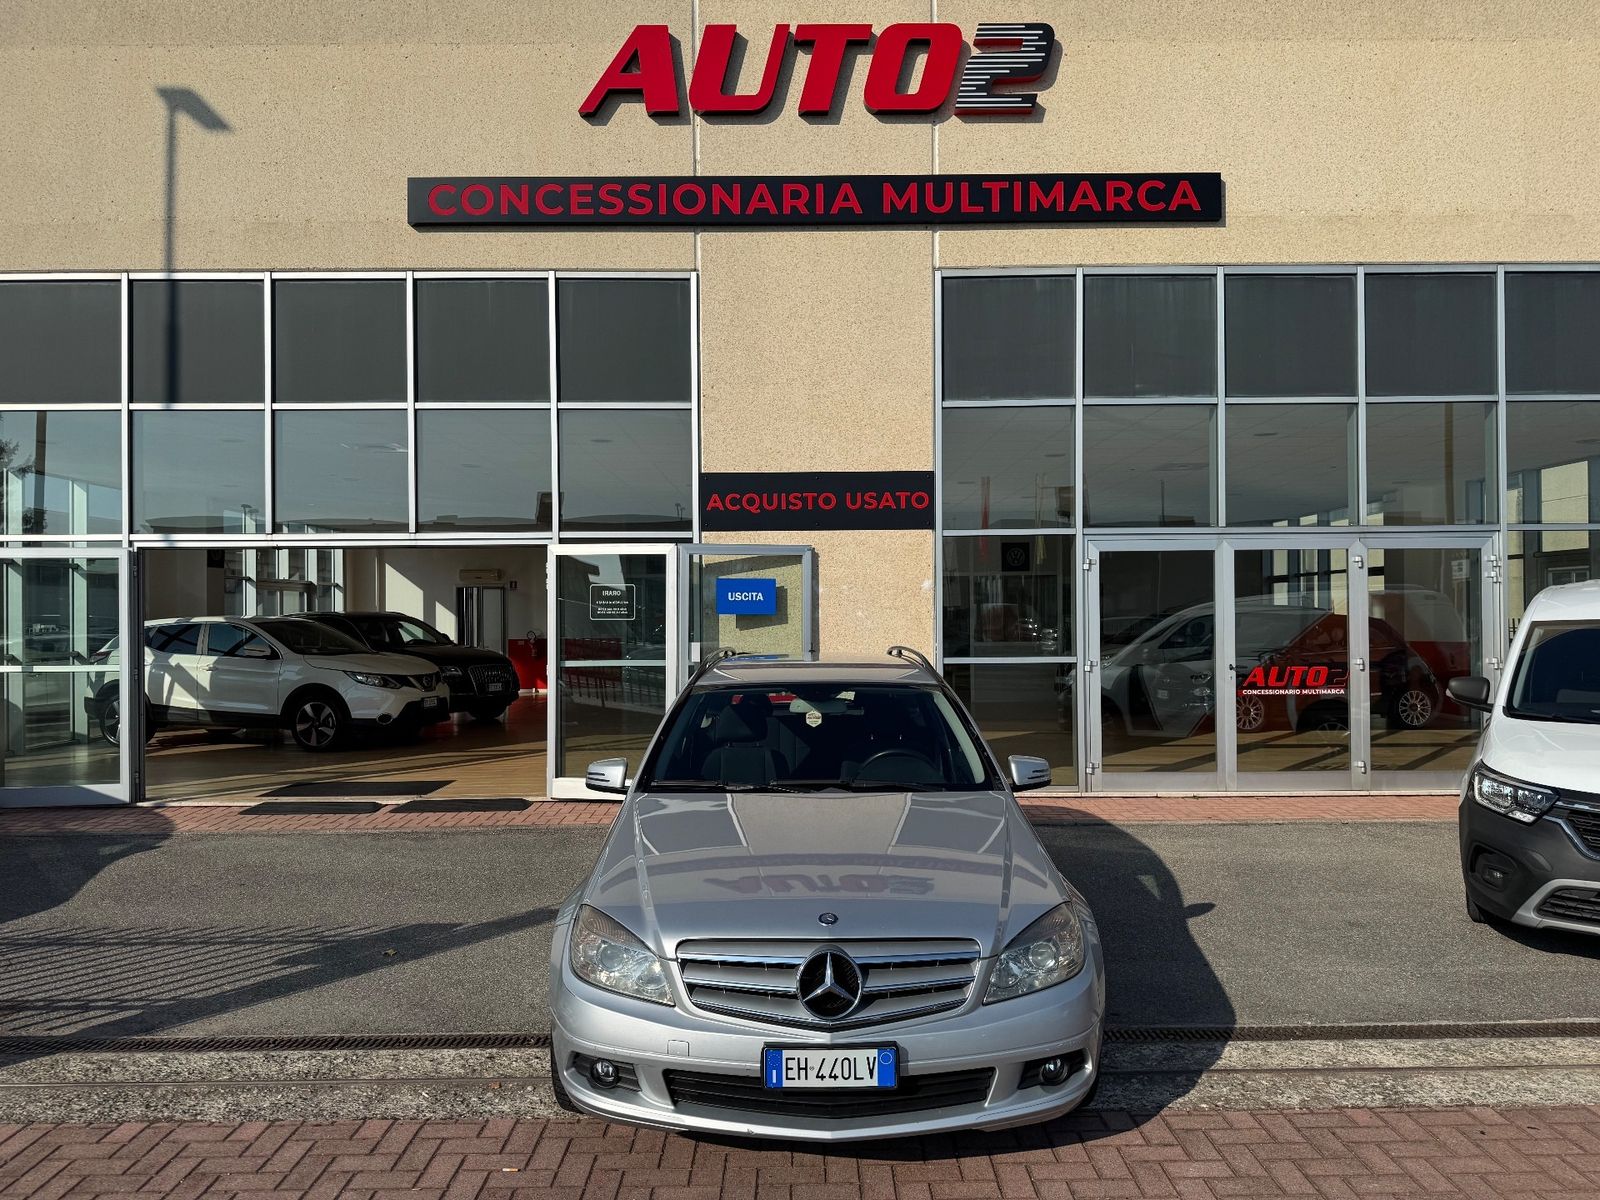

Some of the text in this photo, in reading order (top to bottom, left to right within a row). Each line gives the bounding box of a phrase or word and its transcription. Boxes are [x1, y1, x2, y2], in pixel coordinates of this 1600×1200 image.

[578, 22, 1056, 116] AUTO2
[428, 180, 1201, 216] CONCESSIONARIA MULTIMARCA
[706, 491, 930, 514] ACQUISTO USATO
[727, 592, 764, 602] USCITA
